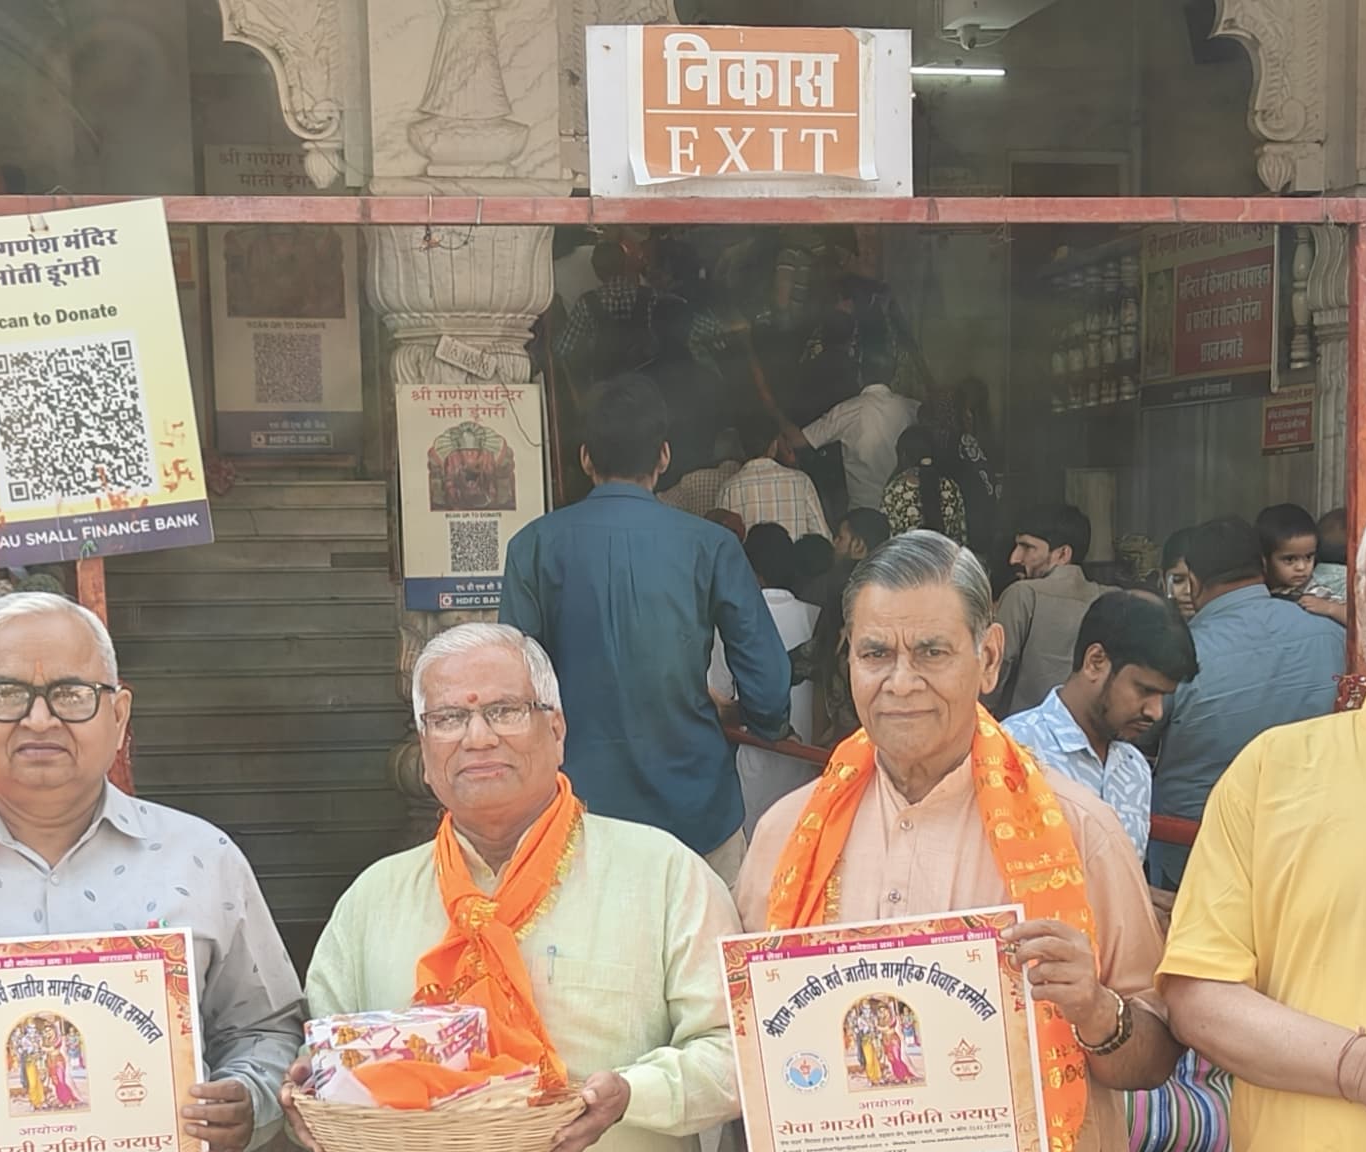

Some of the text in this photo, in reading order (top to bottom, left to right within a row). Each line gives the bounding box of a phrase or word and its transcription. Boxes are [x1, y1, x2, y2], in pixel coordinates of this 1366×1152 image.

[663, 33, 839, 108] निकास
[665, 126, 838, 176] EXIT
[64, 227, 118, 250] मंदिर
[46, 256, 101, 287] डूंगरी
[33, 312, 51, 326] to
[56, 304, 118, 324] Donate
[26, 528, 78, 546] SMALL
[82, 520, 151, 540] FINANCE
[154, 513, 200, 531] BANK
[456, 597, 500, 605] HDFC BAN
[822, 964, 843, 990] सर्व
[842, 958, 878, 982] जातीय
[880, 956, 927, 986] सामूहिक
[926, 962, 961, 993] विवाह
[957, 983, 997, 1020] सम्मेलन
[8, 974, 44, 999] जातीय
[47, 974, 95, 1005] सामूहिक
[94, 981, 128, 1013] विवाह
[124, 1004, 163, 1043] सम्मेलन
[779, 1107, 1008, 1134] सेवा भारती समिति जयपुर
[113, 1135, 173, 1151] जयपुर
